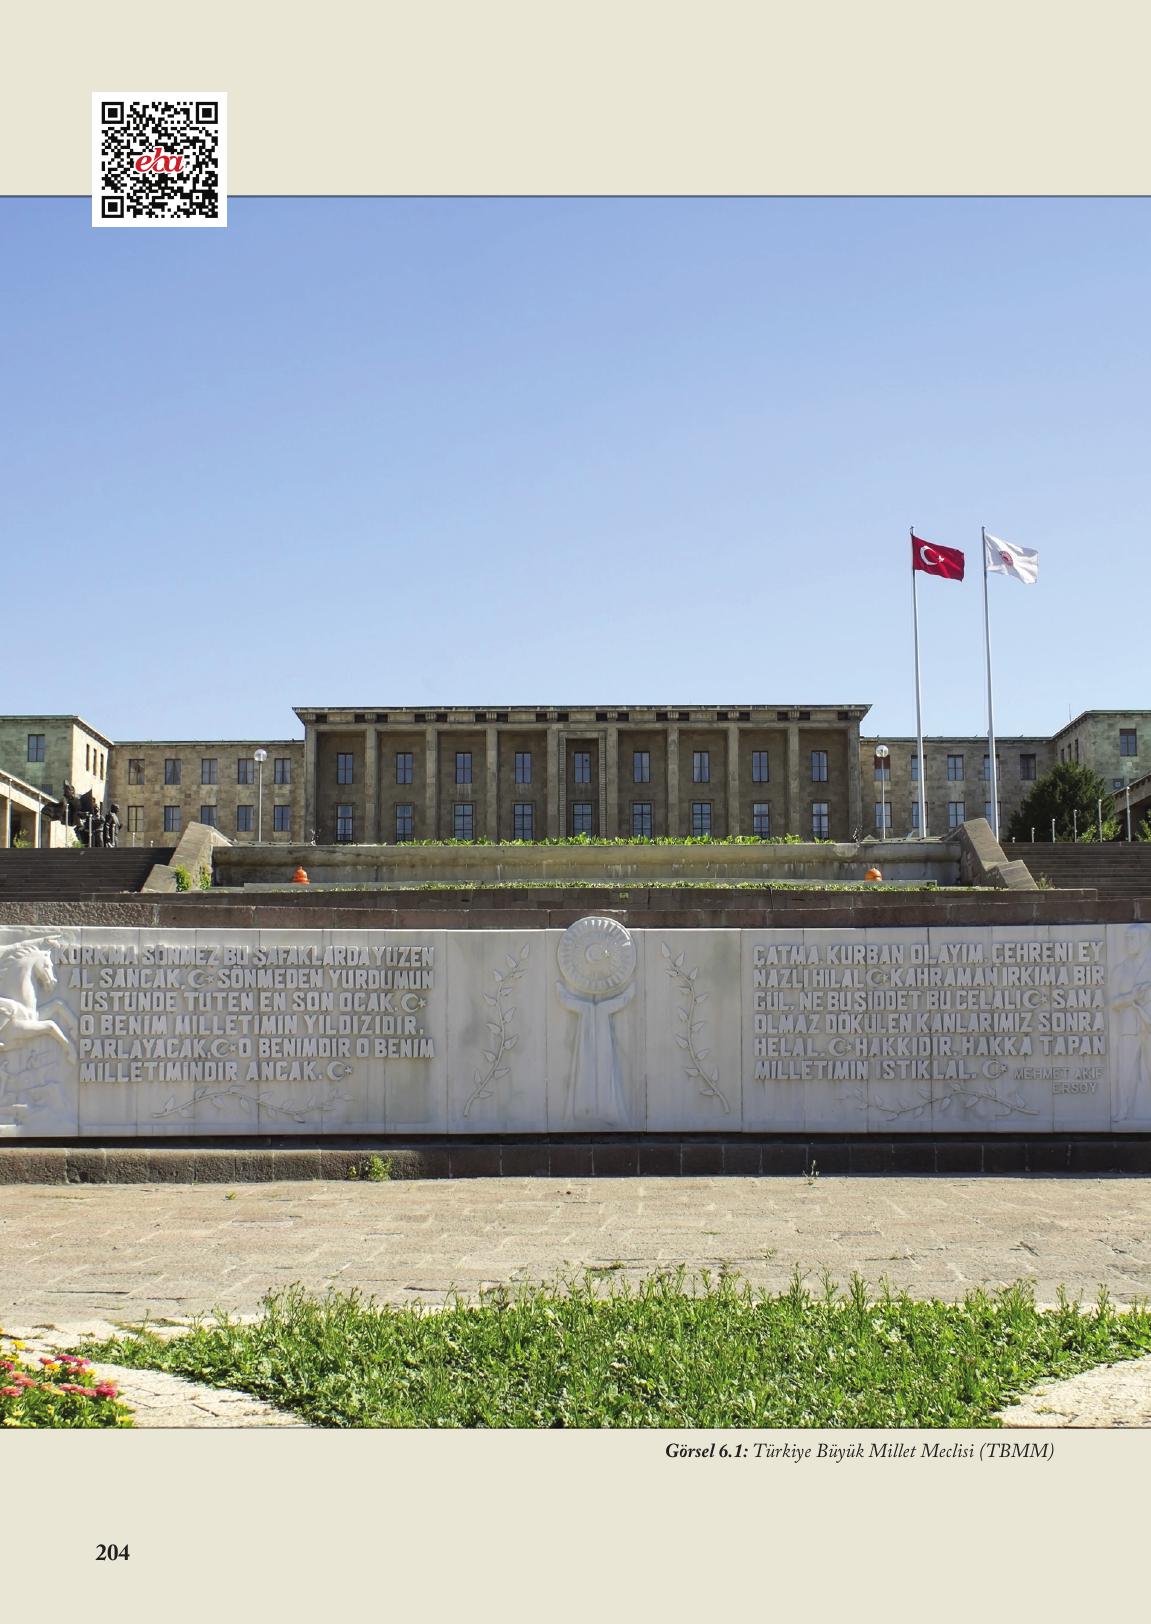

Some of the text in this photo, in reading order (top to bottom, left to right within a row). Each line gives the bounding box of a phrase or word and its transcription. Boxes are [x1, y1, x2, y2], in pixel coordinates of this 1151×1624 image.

[223, 945, 249, 966] BU
[827, 944, 904, 965] KURBAN
[1078, 941, 1105, 962] EY
[69, 968, 94, 989] AL
[328, 969, 434, 990] YURDUMUN
[890, 967, 998, 987] KAHRAMAN
[1003, 966, 1069, 986] IRKIMA
[260, 991, 286, 1012] EN
[292, 991, 334, 1012] SON
[799, 991, 824, 1011] NE
[827, 990, 852, 1011] BU
[926, 990, 951, 1010] BU
[1051, 988, 1105, 1009] SANA
[80, 1014, 94, 1036] O
[754, 1013, 820, 1034] OLMAZ
[916, 1012, 1033, 1034] KANLARIMIZ
[1038, 1011, 1105, 1033] SONRA
[238, 1037, 252, 1058] O
[356, 1037, 370, 1058] O
[961, 1036, 1033, 1056] HAKKA
[1039, 1035, 1106, 1056] TAPAN
